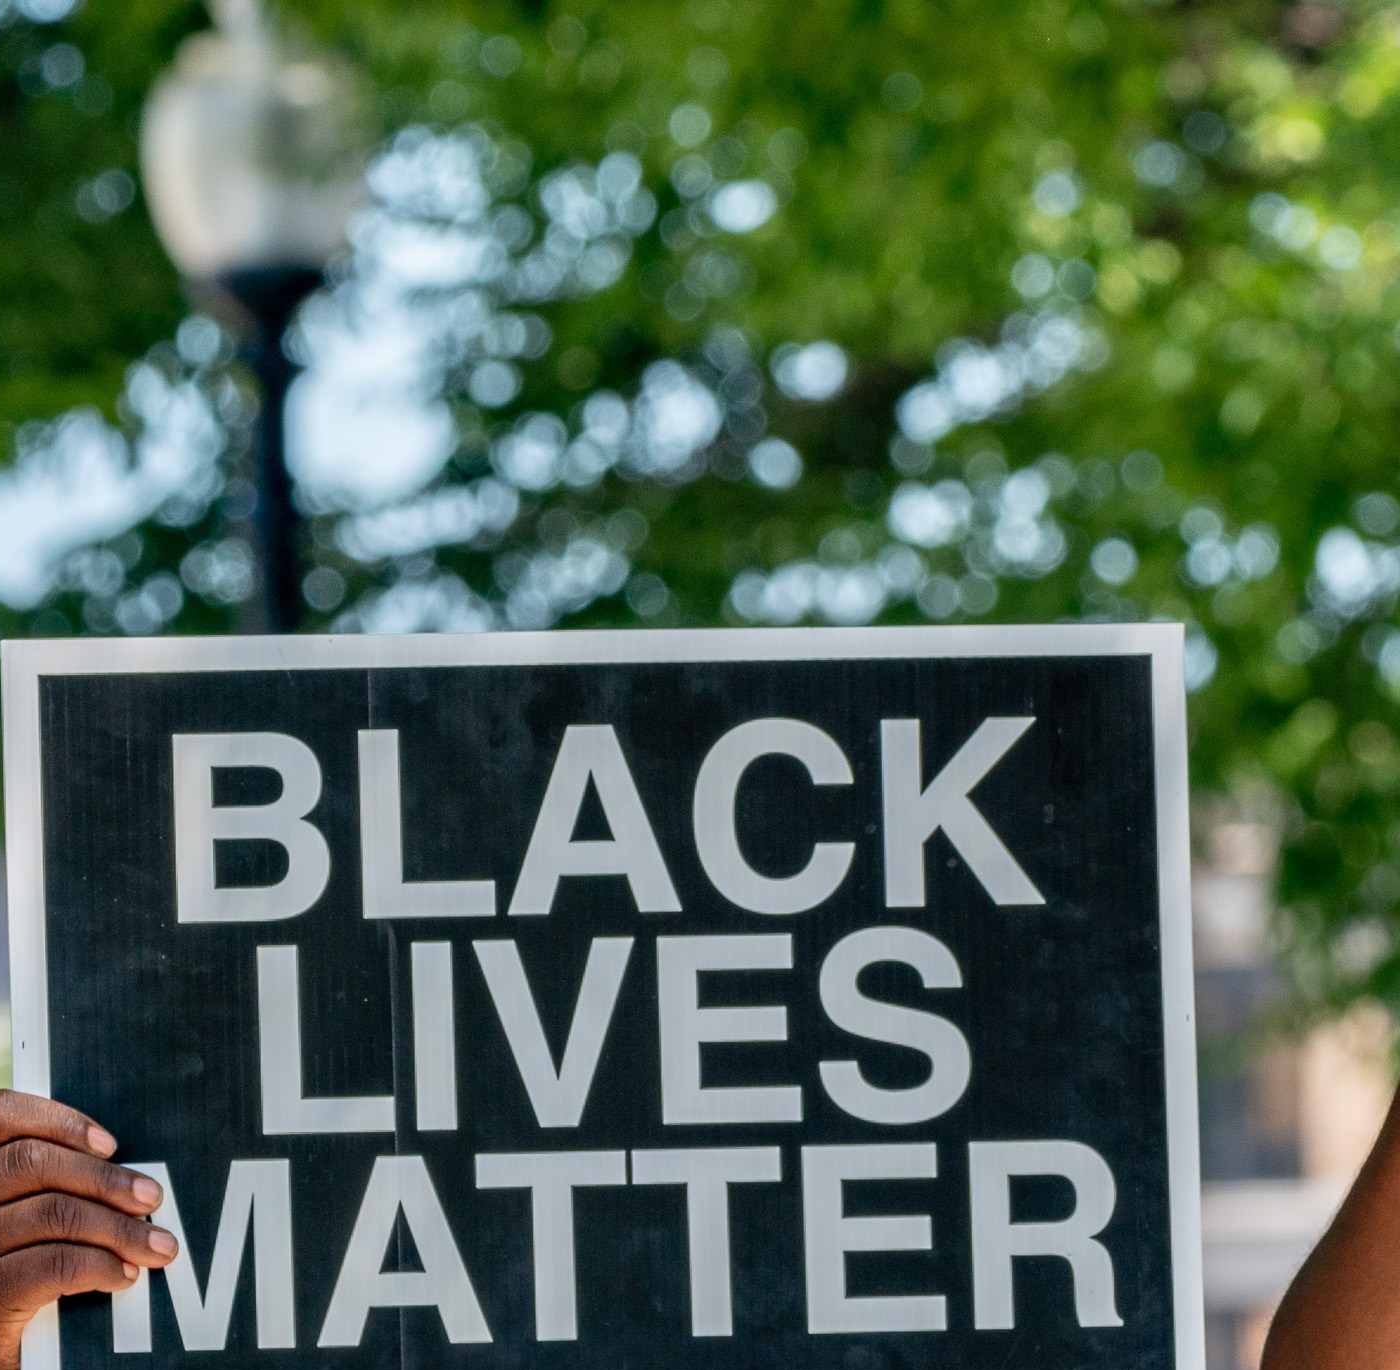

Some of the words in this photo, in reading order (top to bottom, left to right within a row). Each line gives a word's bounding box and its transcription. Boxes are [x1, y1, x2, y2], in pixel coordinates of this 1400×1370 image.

[171, 716, 1047, 924] BLACK
[256, 925, 972, 1137] LIVES
[111, 1140, 1124, 1354] MATTER
